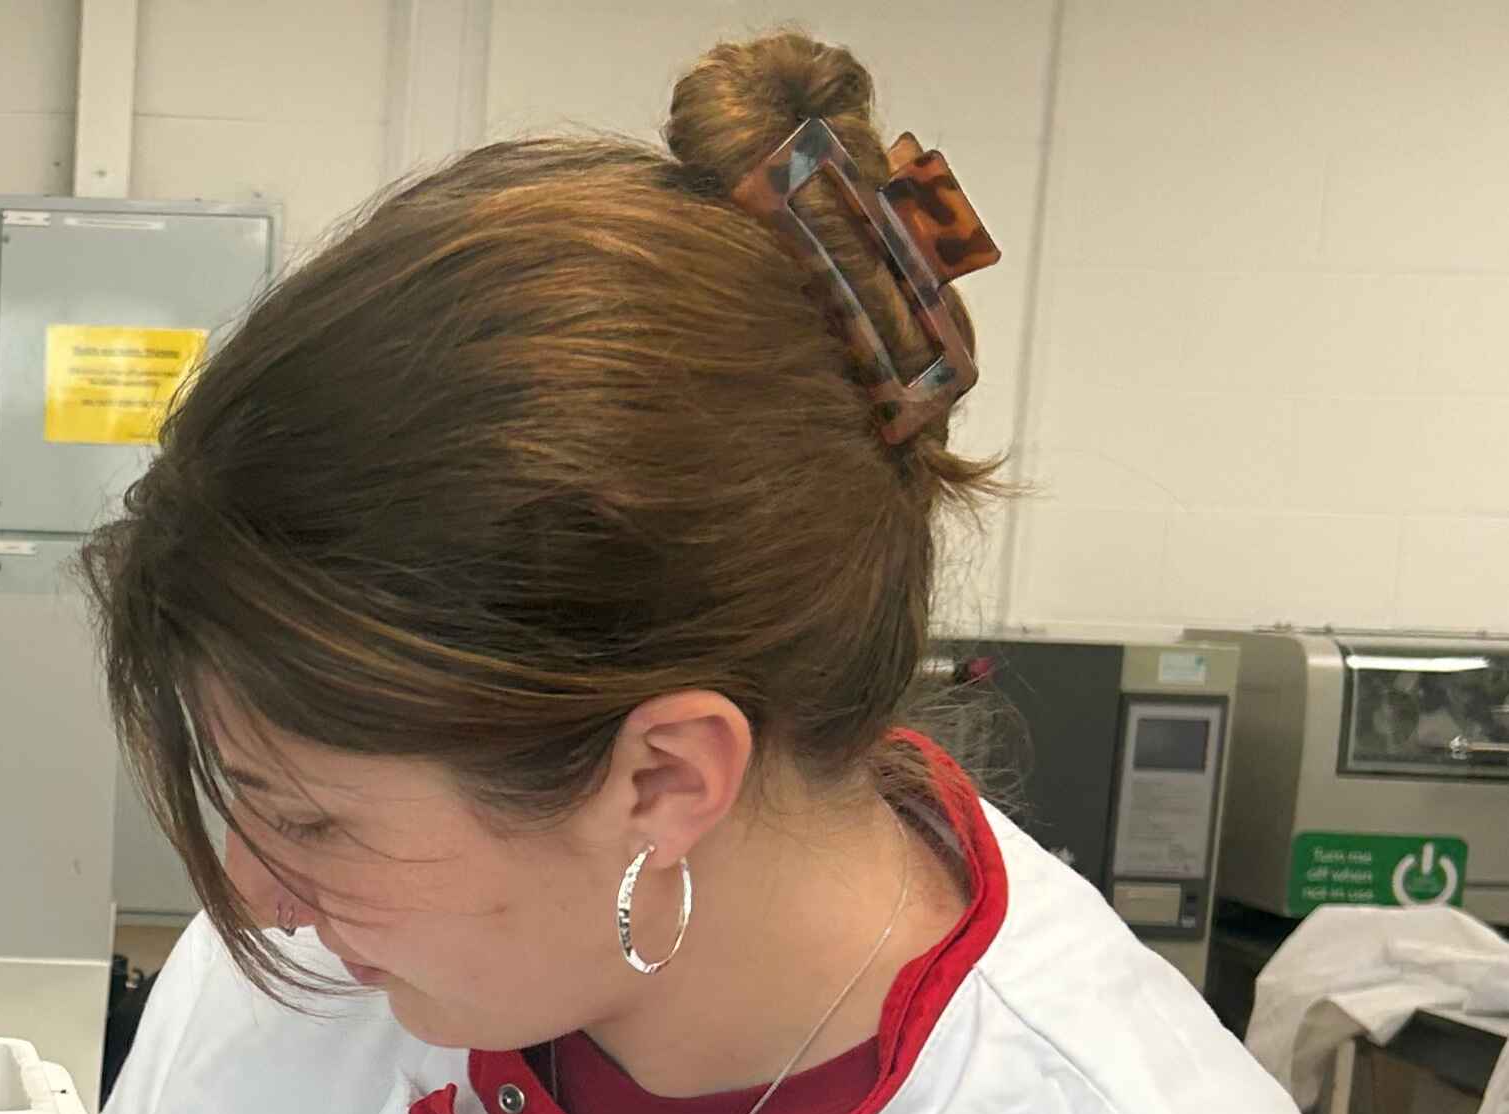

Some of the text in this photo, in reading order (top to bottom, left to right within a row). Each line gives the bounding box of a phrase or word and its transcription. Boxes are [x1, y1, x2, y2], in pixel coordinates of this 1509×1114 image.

[1314, 846, 1372, 863] Turn me
[1306, 867, 1372, 882] off when
